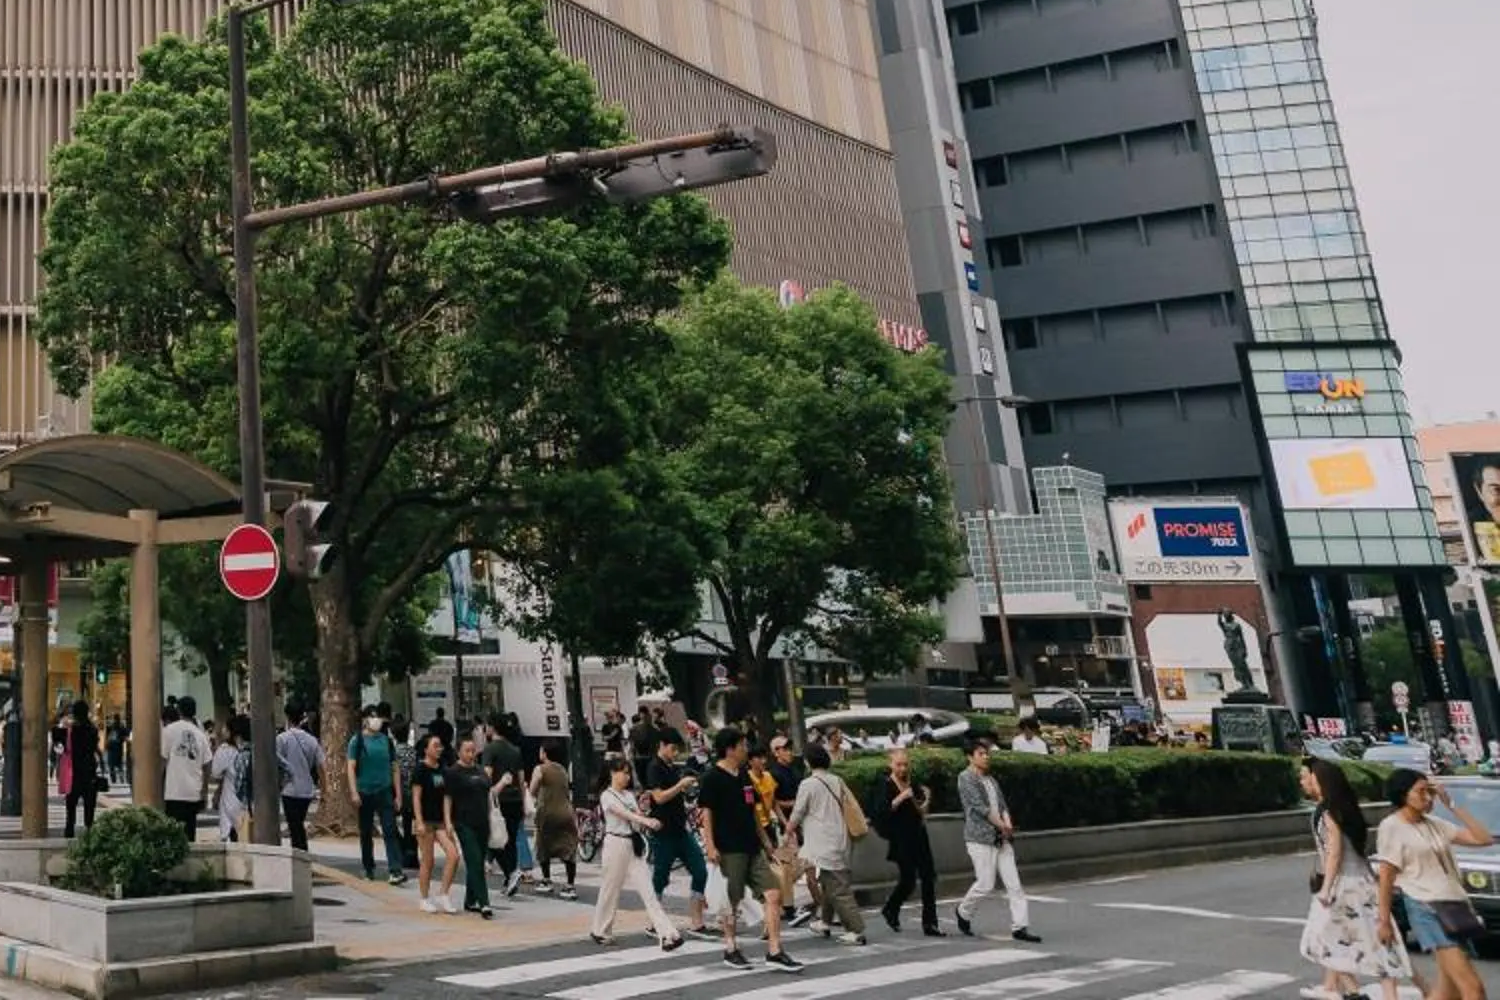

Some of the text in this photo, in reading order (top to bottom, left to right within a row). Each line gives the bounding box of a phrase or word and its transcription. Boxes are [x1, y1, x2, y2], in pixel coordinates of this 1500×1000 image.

[1163, 522, 1237, 538] PROMISE
[1134, 559, 1220, 576] この先30m
[539, 645, 557, 712] Station
